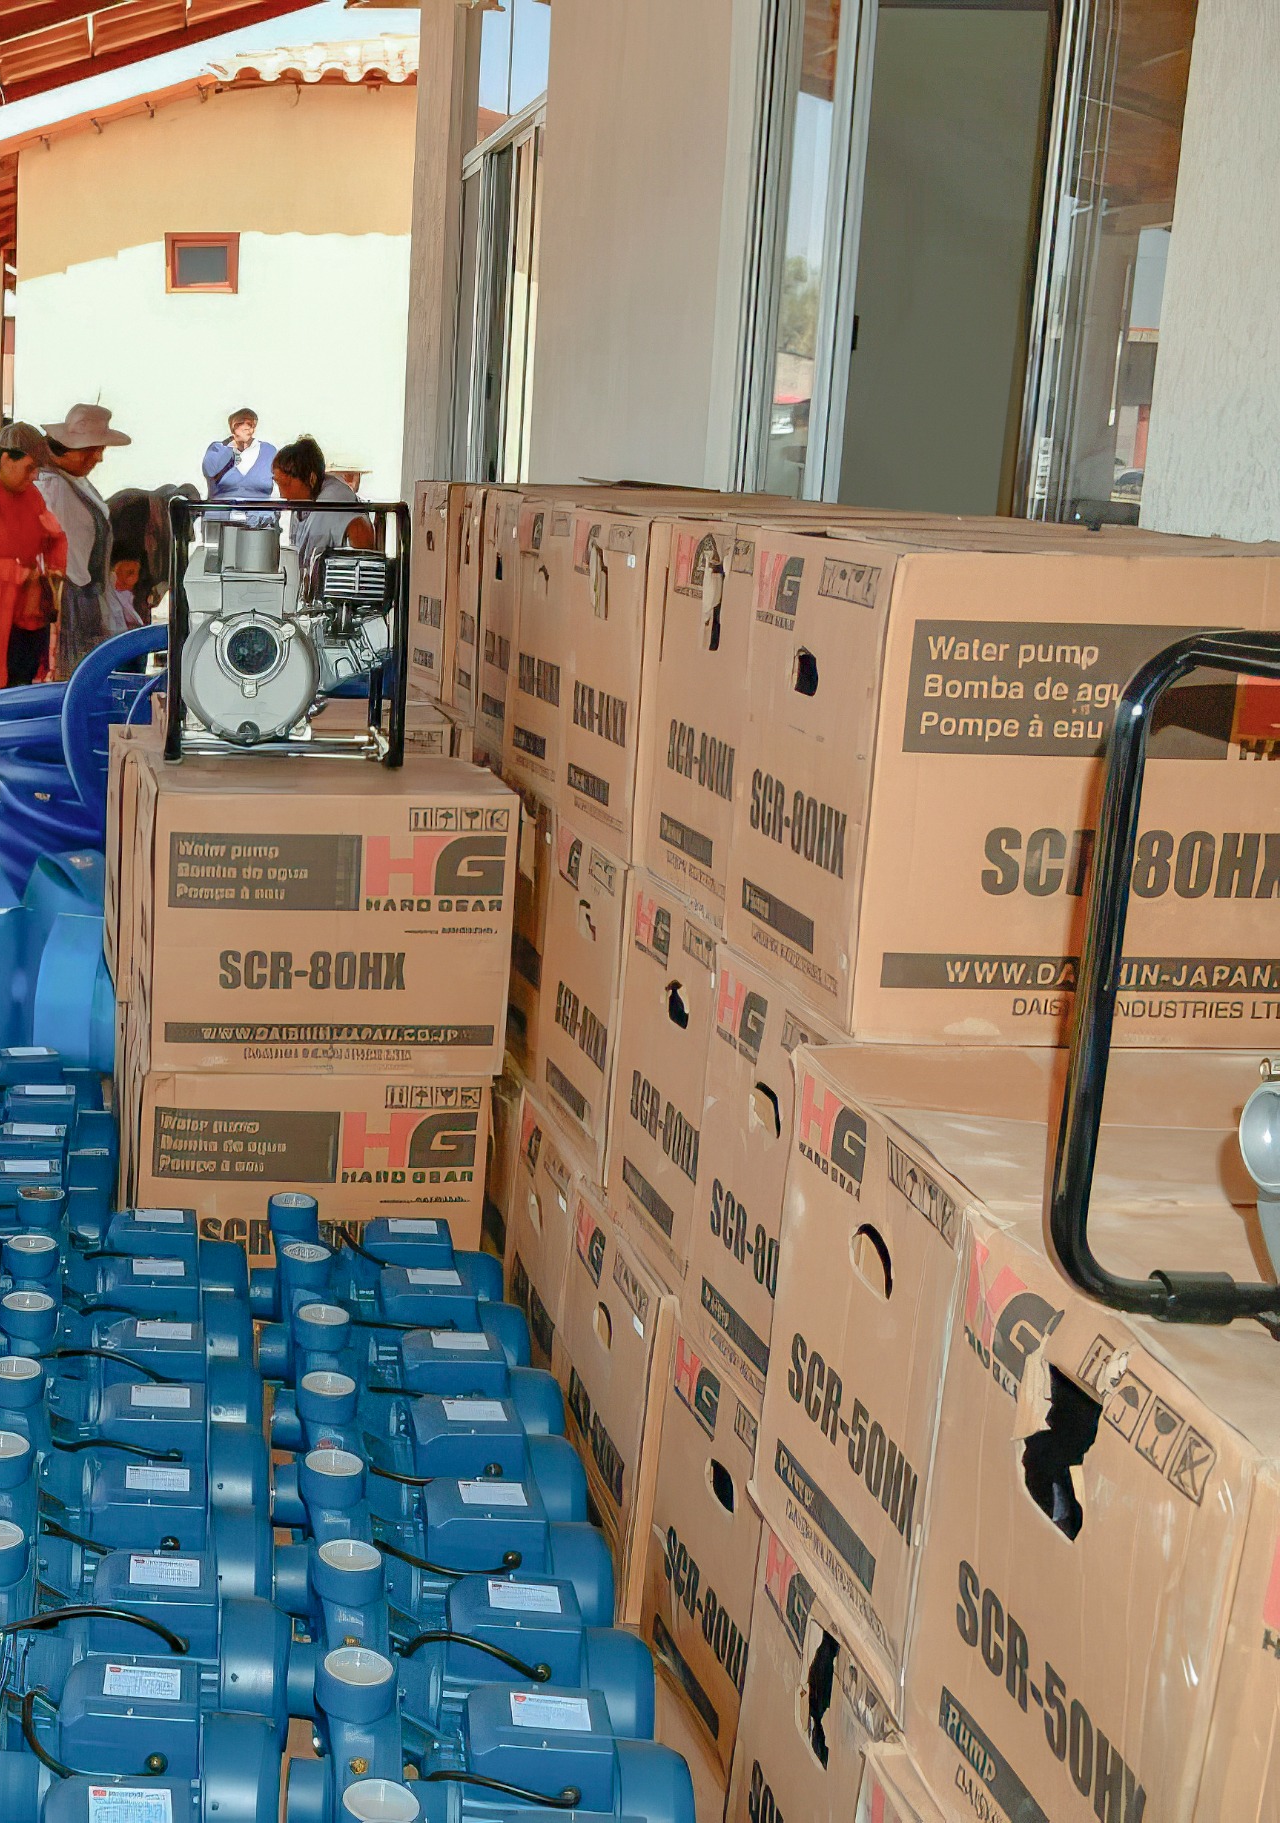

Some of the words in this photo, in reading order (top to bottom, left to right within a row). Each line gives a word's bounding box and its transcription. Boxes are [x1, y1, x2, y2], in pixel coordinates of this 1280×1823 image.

[928, 635, 1009, 662] Water
[1018, 644, 1099, 670] pump
[923, 674, 1025, 700] Bomba
[1033, 676, 1069, 701] de
[919, 711, 1019, 742] Pompe
[1028, 713, 1044, 738] à
[1053, 720, 1104, 739] eau
[366, 835, 507, 896] HG
[219, 949, 406, 991] SCR-80HX
[342, 1112, 478, 1168] HG
[799, 1071, 867, 1184] HG
